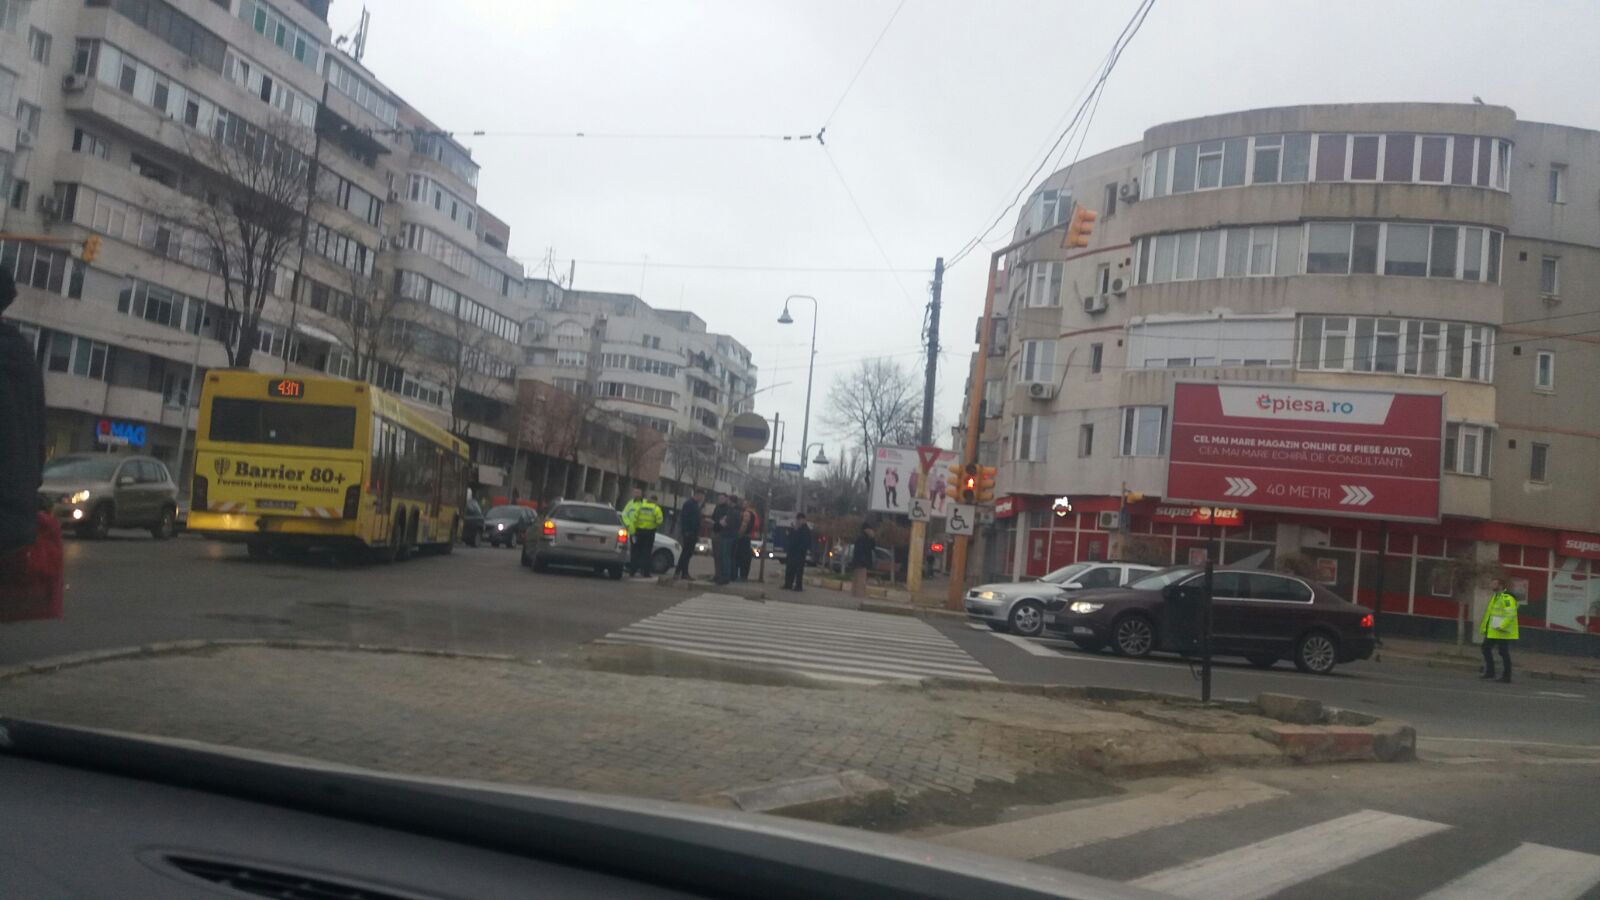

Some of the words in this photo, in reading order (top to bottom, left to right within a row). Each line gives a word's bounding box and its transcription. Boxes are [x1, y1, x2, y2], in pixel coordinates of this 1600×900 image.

[1256, 393, 1354, 415] epiesa.ro
[1193, 434, 1210, 444] CEL
[1211, 435, 1229, 445] MAI
[1230, 437, 1256, 447] MARE
[1257, 439, 1300, 449] MAGAZIN
[1301, 441, 1337, 452] ONLINE
[1338, 443, 1353, 453] DE
[1354, 444, 1381, 455] PIESE
[1382, 446, 1413, 458] AUTO,
[1221, 447, 1240, 457] MAI
[1241, 448, 1269, 458] MARE
[1310, 452, 1325, 463] DE
[235, 460, 305, 482] Barrier
[309, 467, 347, 485] 80+
[287, 484, 299, 492] cu
[1266, 483, 1286, 496] 40
[1288, 485, 1331, 499] METRI
